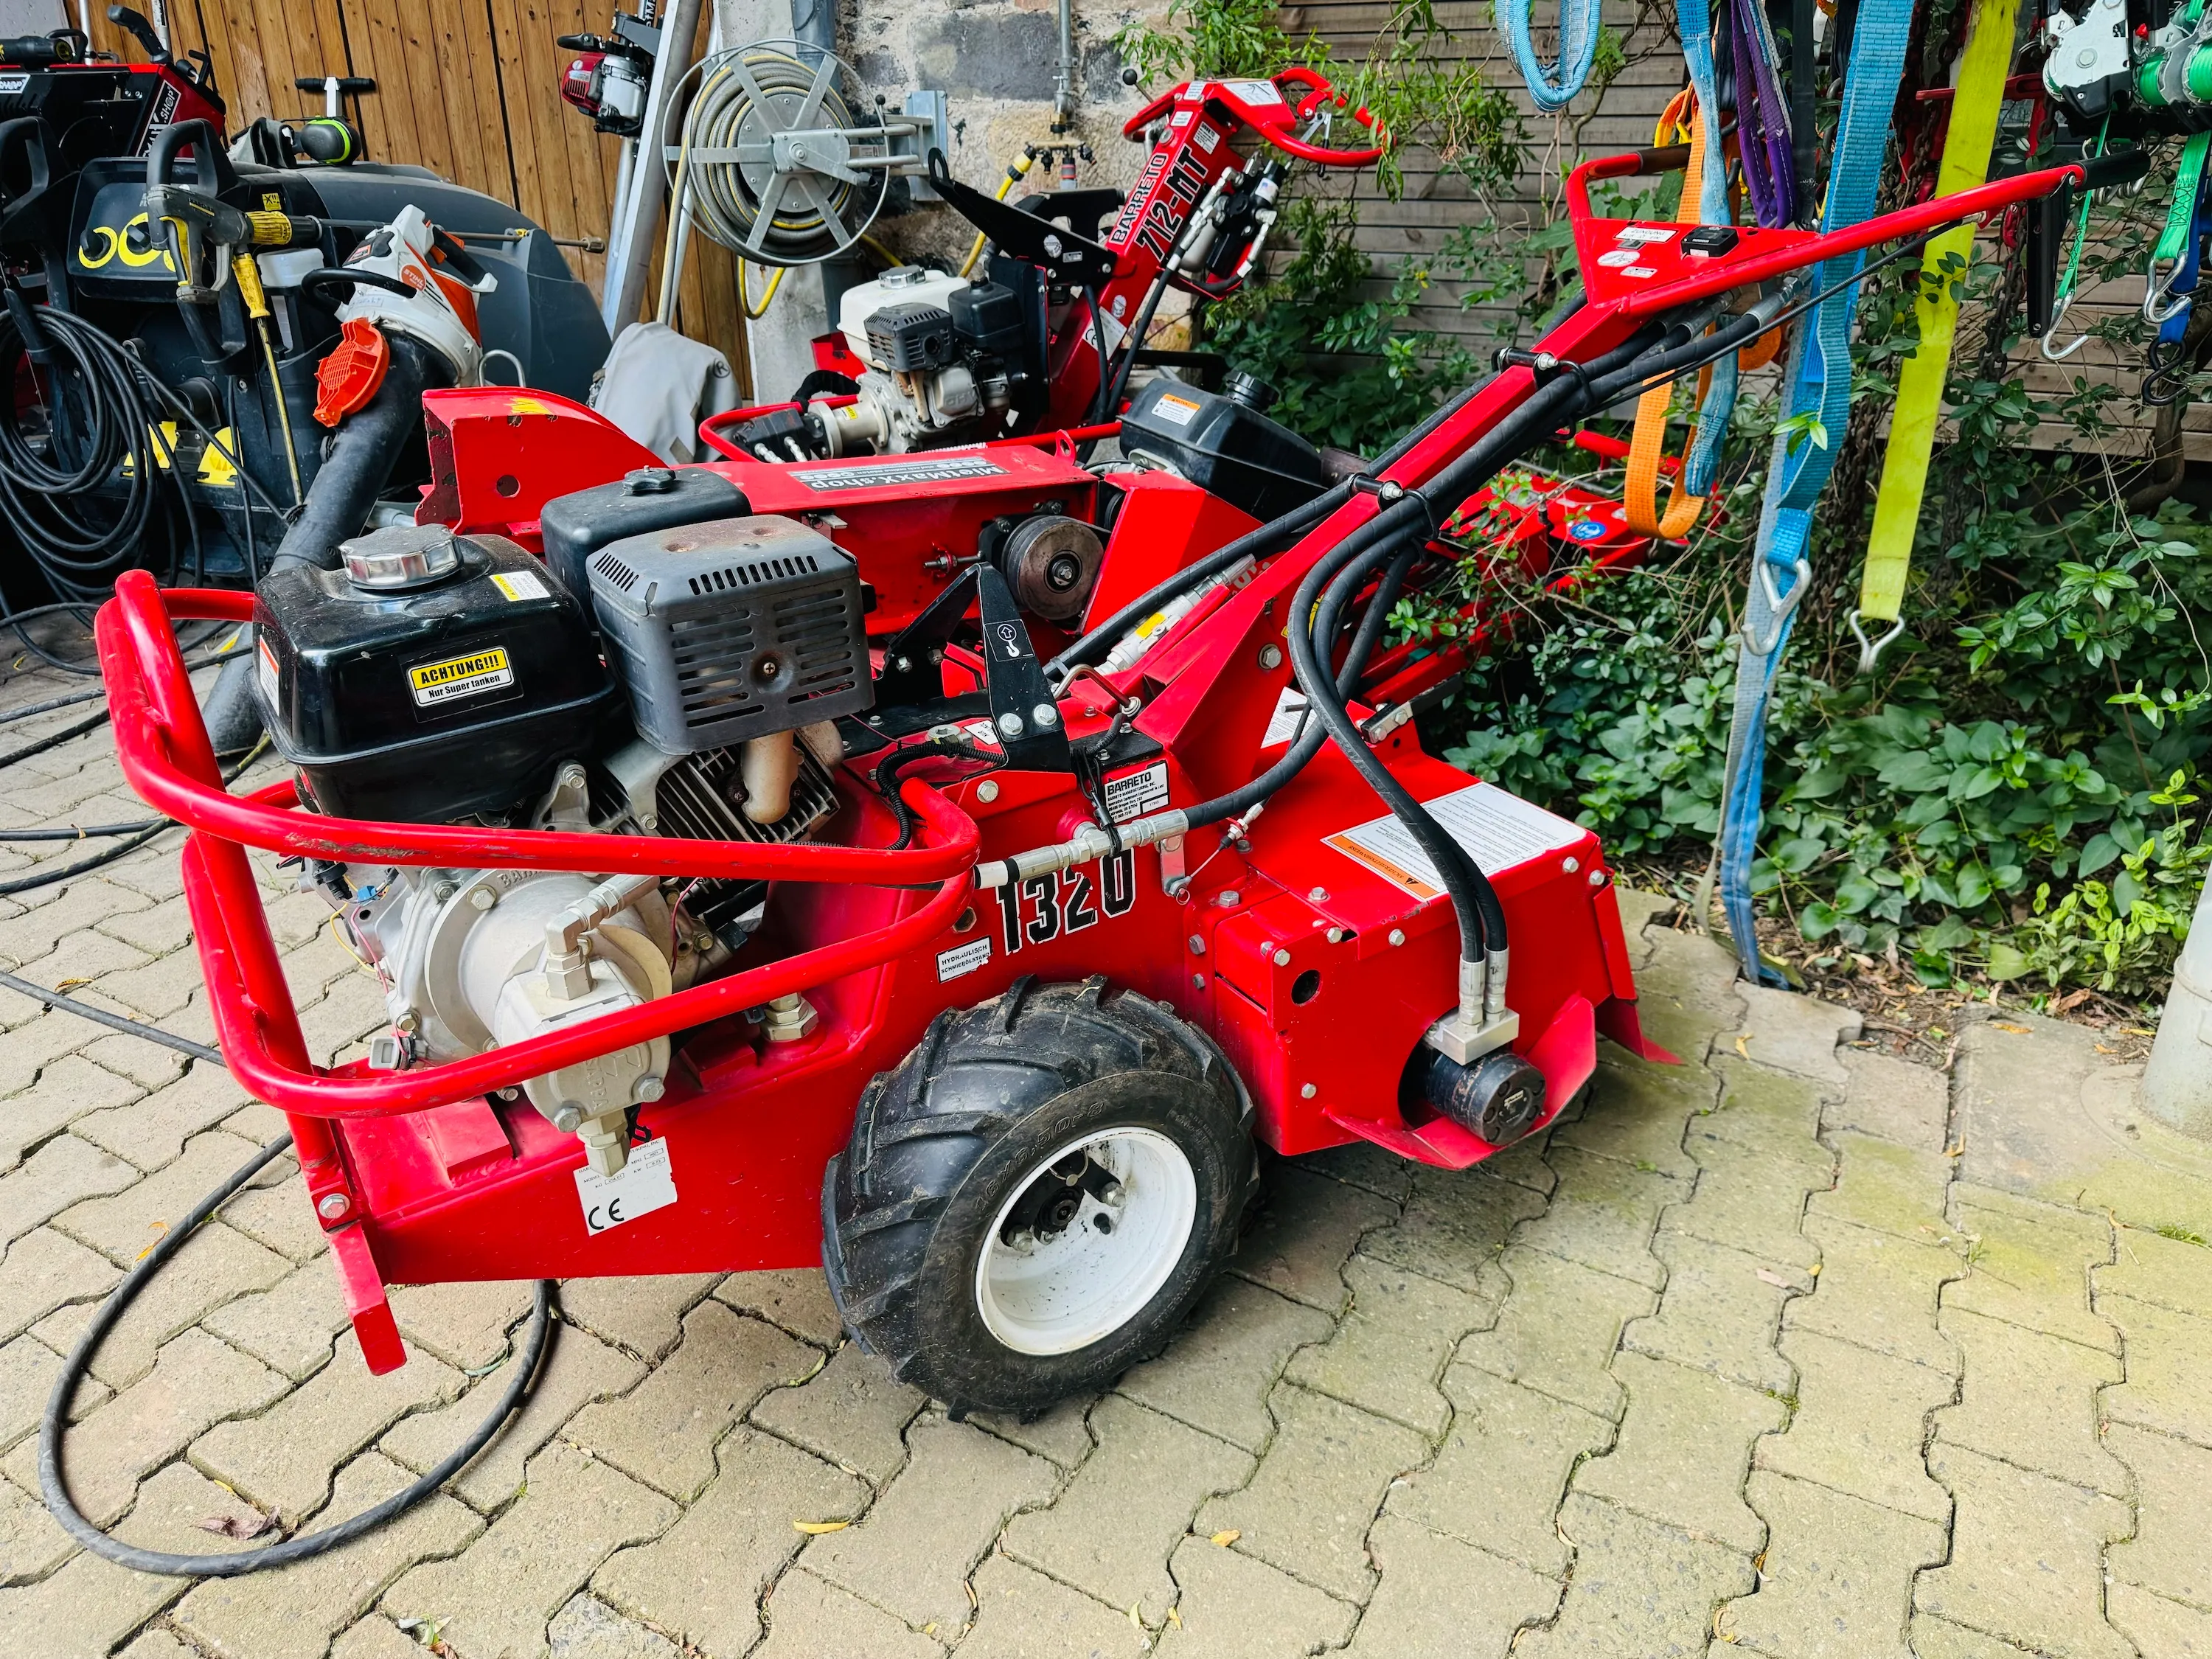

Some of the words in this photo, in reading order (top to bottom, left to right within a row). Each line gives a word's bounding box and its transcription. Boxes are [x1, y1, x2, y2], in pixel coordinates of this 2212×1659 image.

[1109, 153, 1169, 245] BARRETO
[1134, 143, 1208, 262] 712-MT
[403, 268, 424, 286] STIHL
[420, 654, 499, 684] ACHTUNG!!!
[428, 689, 443, 698] Nur
[445, 683, 470, 695] Super
[471, 675, 501, 688] tanken
[1107, 771, 1152, 796] BARRETO
[996, 847, 1135, 956] 1320
[942, 945, 987, 965] HYDRAULISCH
